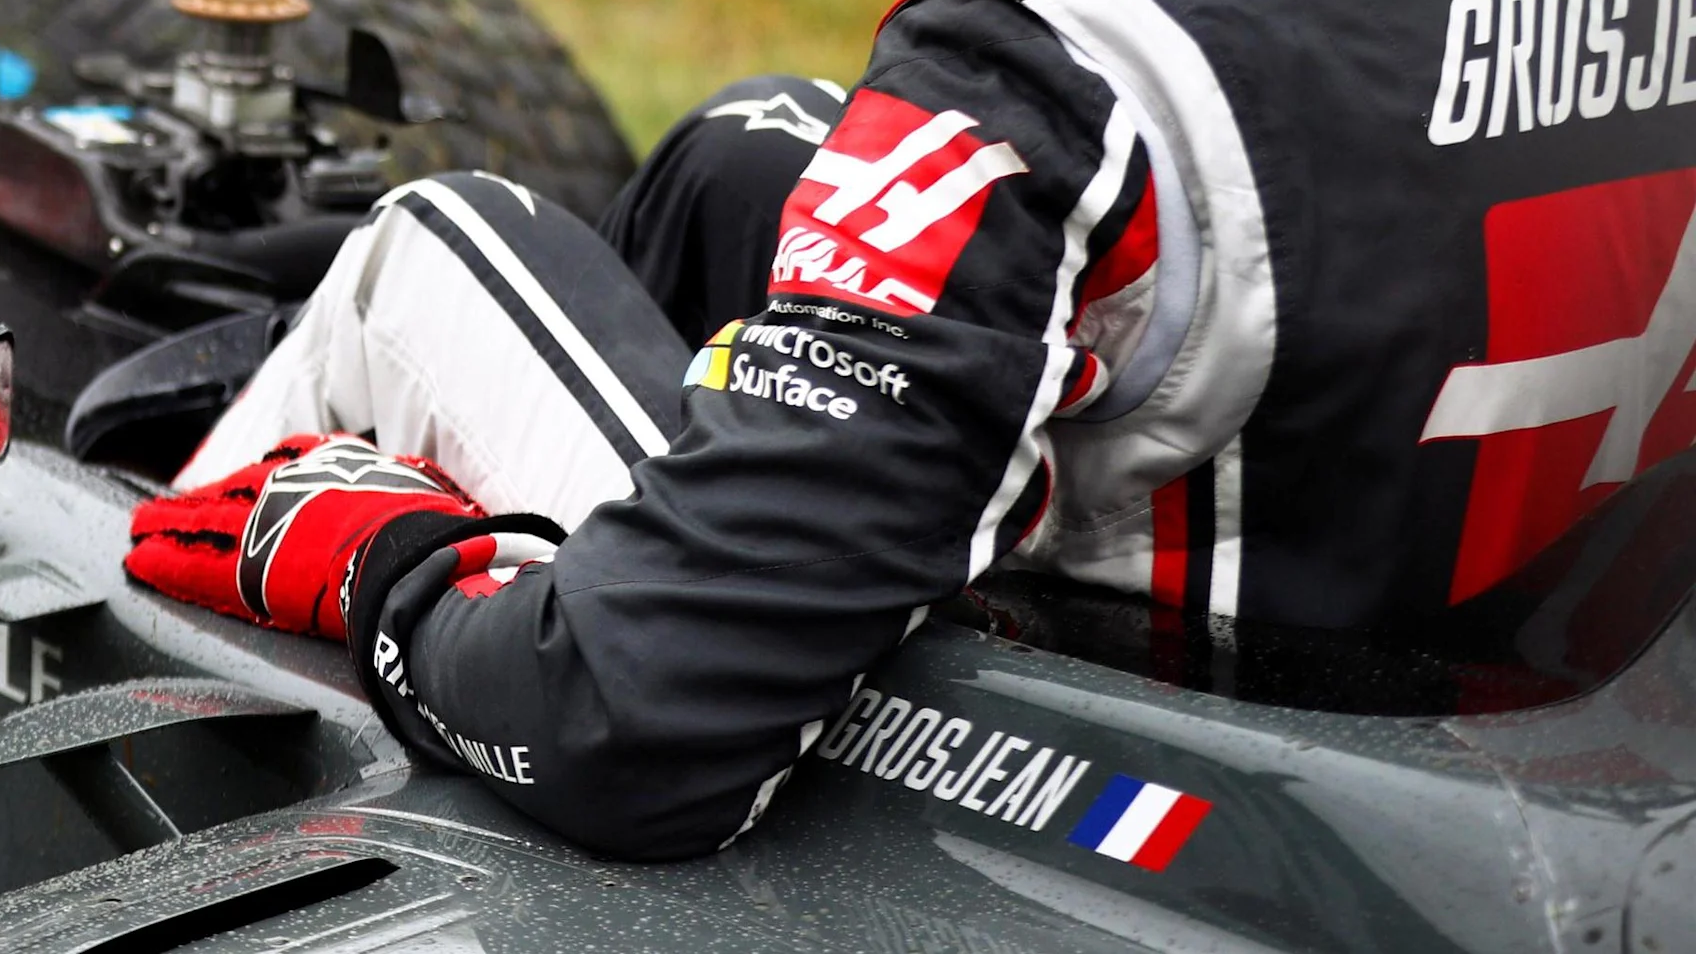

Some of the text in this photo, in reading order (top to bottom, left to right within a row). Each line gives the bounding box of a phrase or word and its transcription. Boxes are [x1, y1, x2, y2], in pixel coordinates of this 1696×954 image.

[768, 300, 910, 340] Automation Inc.
[729, 353, 858, 420] Surface
[742, 324, 911, 405] Microsoft
[456, 733, 535, 785] MILLE
[816, 687, 1091, 832] GROSJEAN
